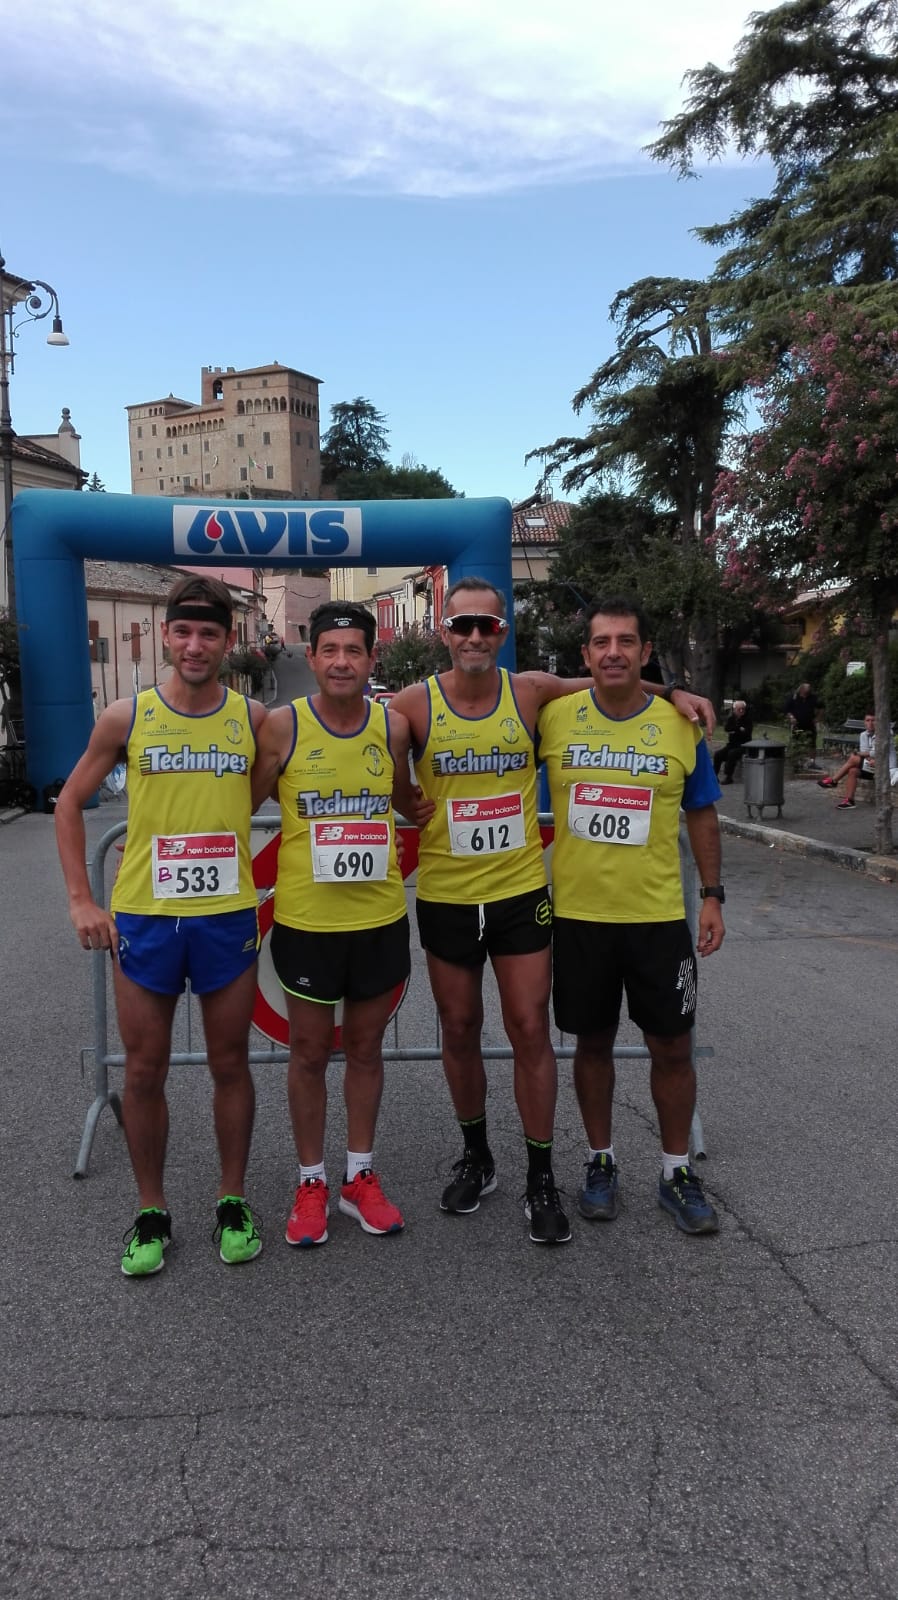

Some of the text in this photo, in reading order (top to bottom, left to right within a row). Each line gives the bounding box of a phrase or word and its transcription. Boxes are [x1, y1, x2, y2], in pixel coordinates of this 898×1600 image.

[187, 509, 350, 556] AVIS
[144, 744, 248, 778] Technipes
[434, 746, 528, 777] Technipes
[568, 744, 667, 777] Technipes
[618, 797, 648, 806] balance
[360, 831, 387, 840] balance
[470, 824, 510, 852] 612
[588, 813, 631, 839] 608
[204, 846, 234, 854] balance
[158, 866, 172, 883] B
[333, 851, 374, 878] 690
[175, 865, 220, 893] 533
